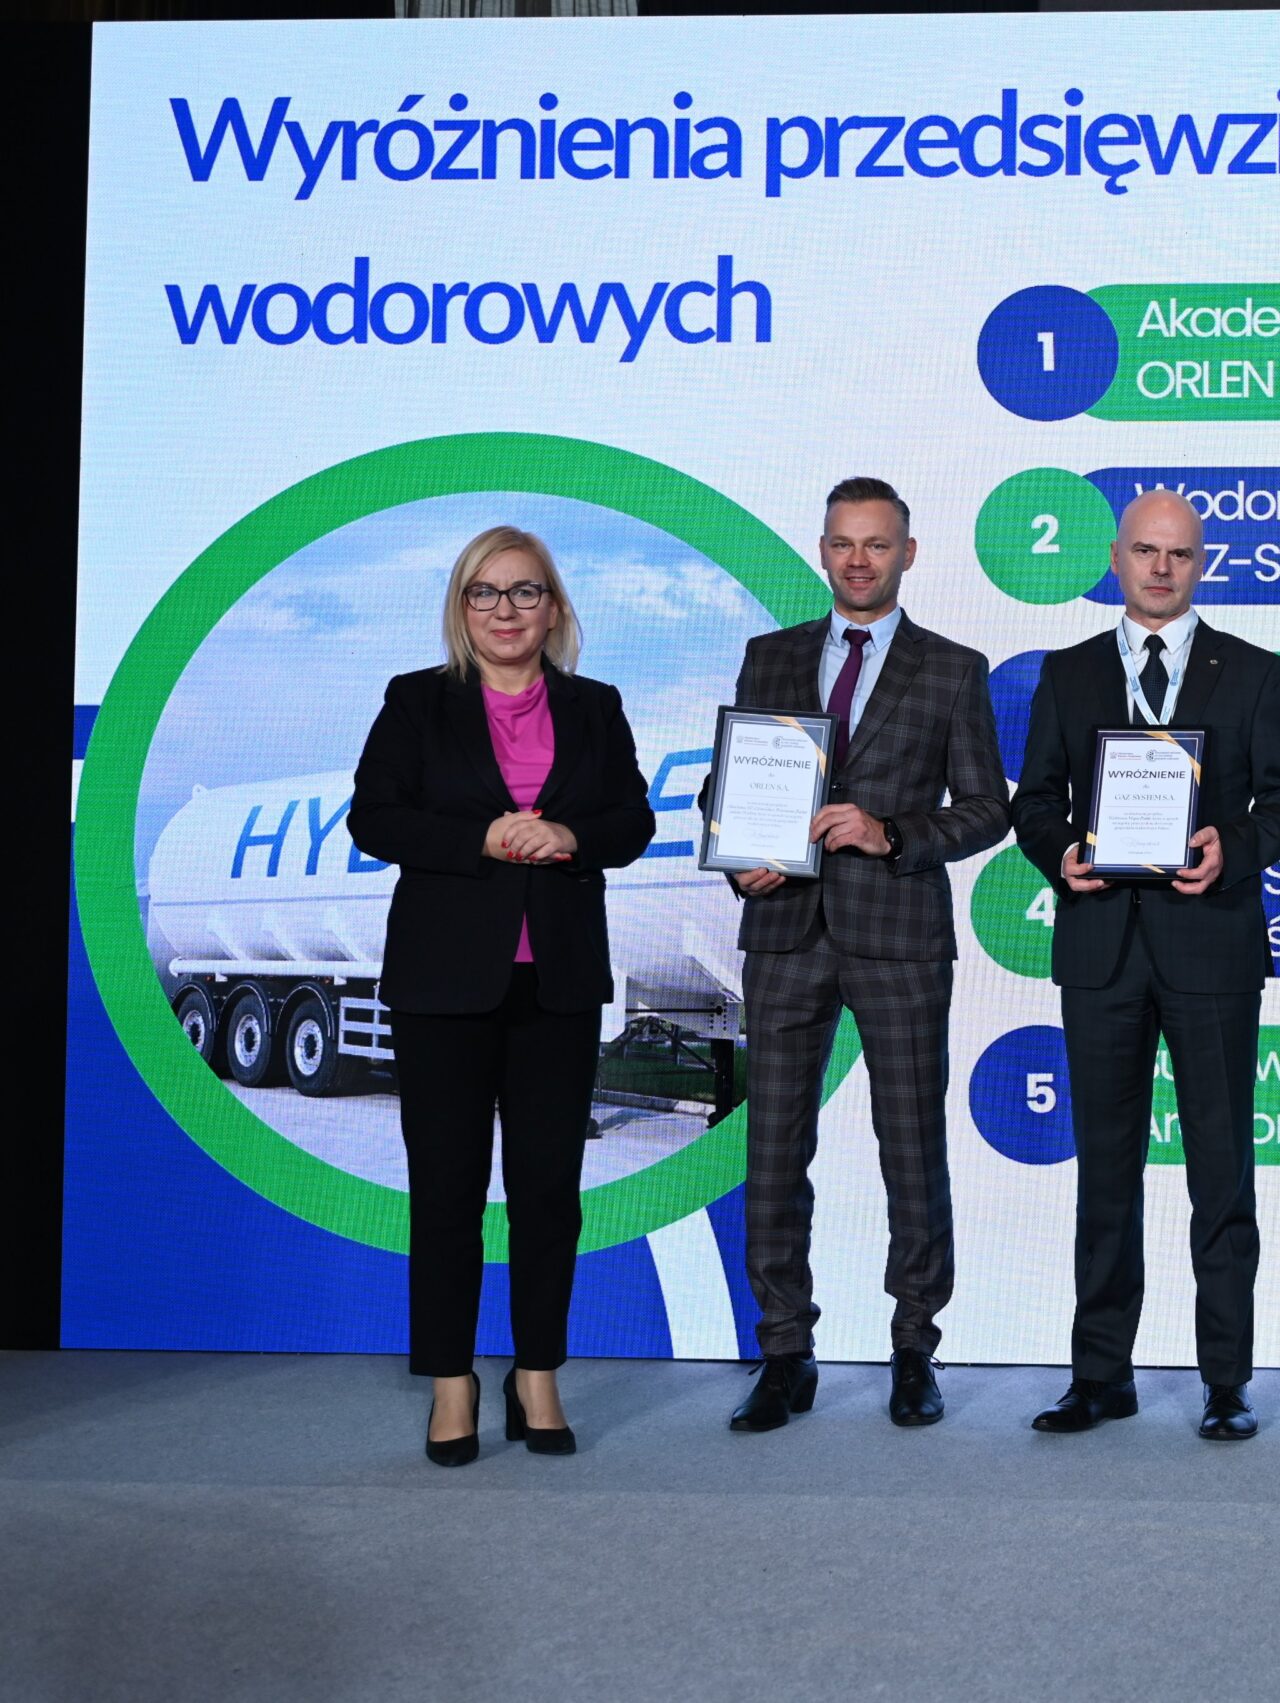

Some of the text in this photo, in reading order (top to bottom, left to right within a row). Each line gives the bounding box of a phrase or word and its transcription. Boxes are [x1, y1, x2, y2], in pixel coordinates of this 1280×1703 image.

[168, 93, 743, 200] Wyróżnienia
[165, 255, 772, 362] wodorowych
[1037, 332, 1055, 372] 1
[1136, 360, 1275, 400] ORLEN
[1031, 514, 1060, 554] 2
[733, 755, 812, 770] WYRÓŻNIENIE
[1108, 768, 1186, 779] WYRÓŻNIENIE
[1025, 887, 1056, 927] 4
[1026, 1073, 1057, 1114] 5
